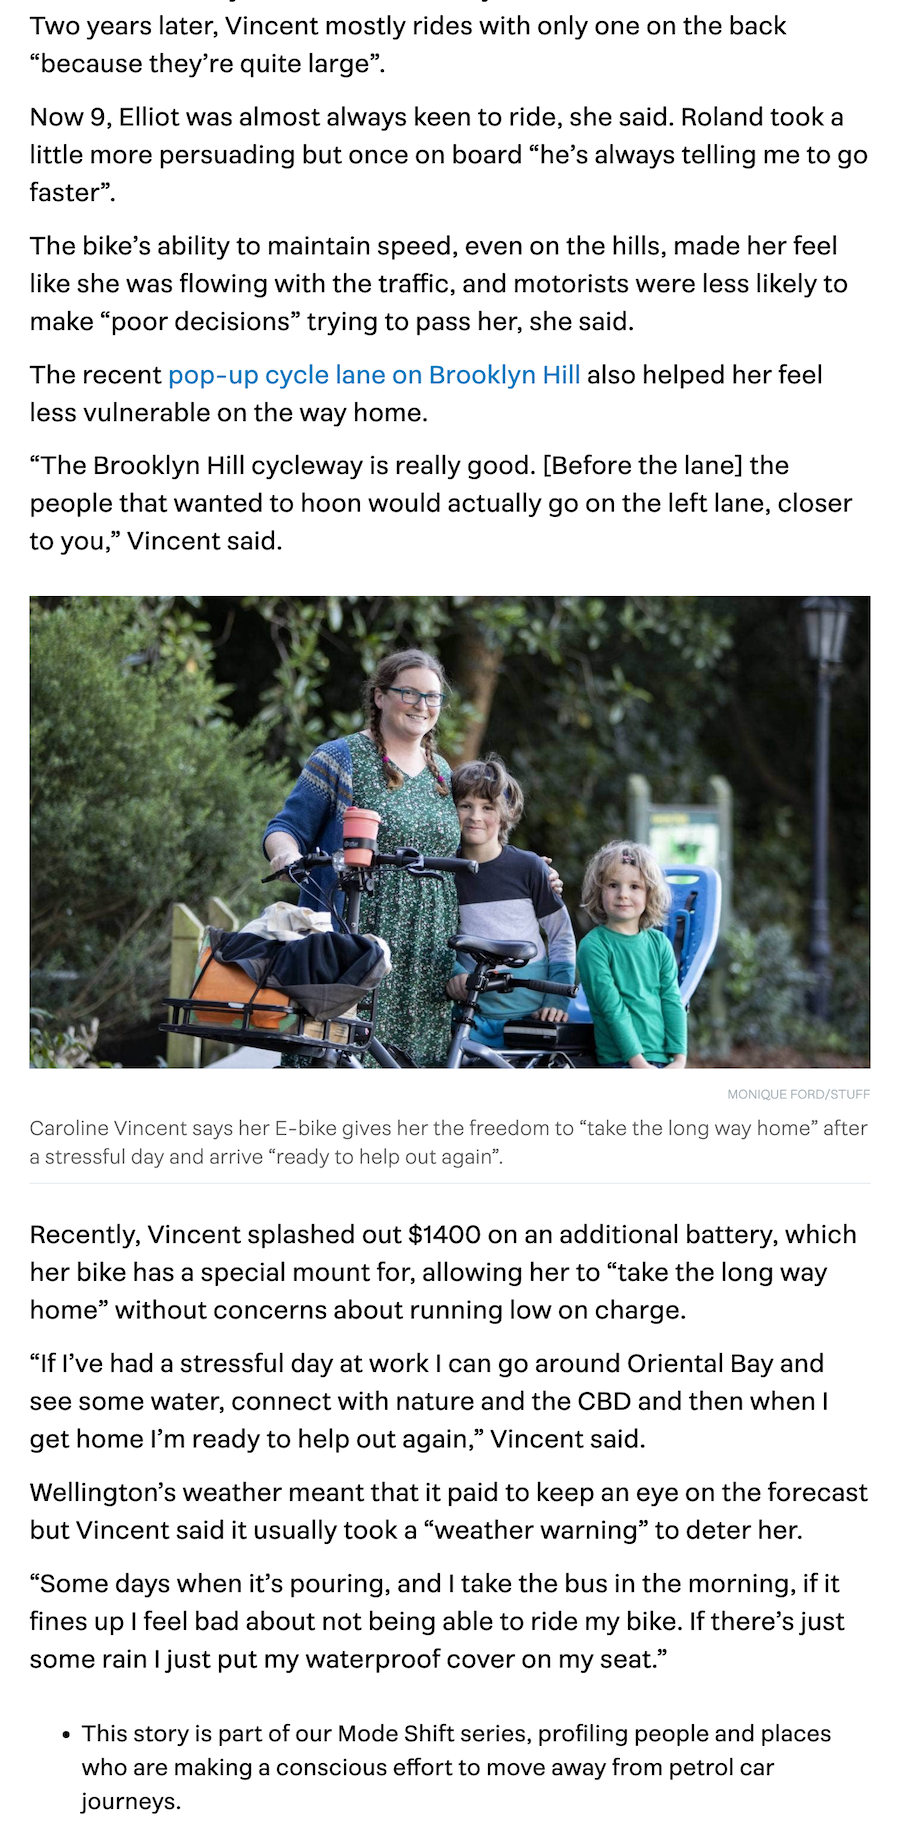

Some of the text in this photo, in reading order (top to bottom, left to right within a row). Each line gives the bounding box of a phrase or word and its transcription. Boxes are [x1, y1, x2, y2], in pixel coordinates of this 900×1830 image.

[29, 364, 821, 389] The recent pop-up cycle lane on Brooklyn Hill also helped her feel
[728, 1089, 870, 1100] MONIQUE FORD/STUFF
[30, 1148, 502, 1168] a stressful day and arrive “ready to help out again”.
[31, 1223, 856, 1249] Recently, Vincent splashed out $1400 on an additional battery, which
[81, 1724, 831, 1746] This story is part of our Mode Shift series, profiling people and places
[80, 1792, 180, 1814] journeys.
